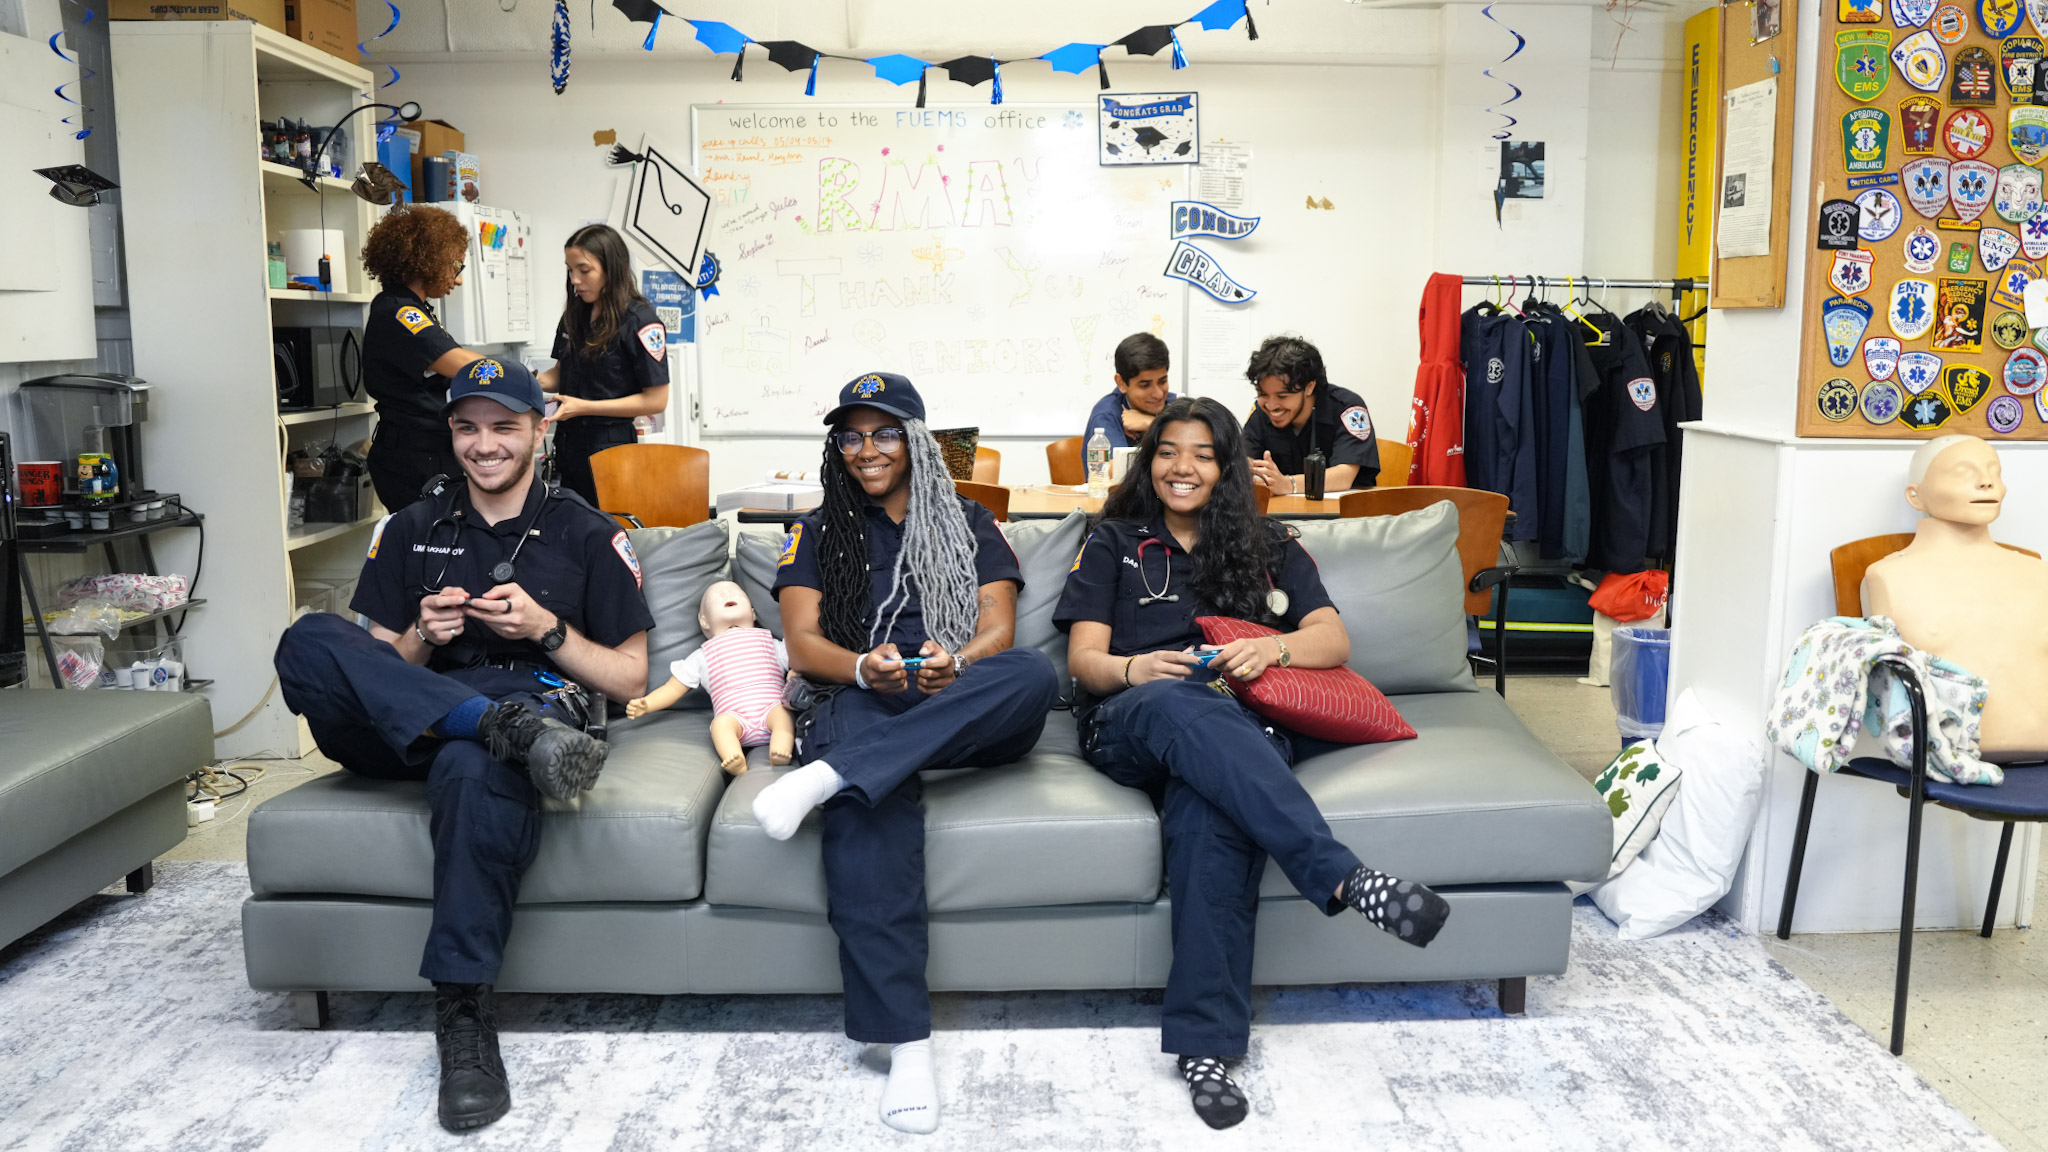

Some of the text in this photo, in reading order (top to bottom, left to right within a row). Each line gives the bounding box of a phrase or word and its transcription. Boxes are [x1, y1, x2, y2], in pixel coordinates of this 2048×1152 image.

[1839, 33, 1855, 44] NEW
[1904, 33, 1928, 52] EMT
[1854, 82, 1882, 92] EMS
[2012, 85, 2032, 93] EMS
[1113, 104, 1183, 117] CONGRATS GRAD
[1910, 104, 1931, 112] EMS
[729, 110, 1047, 129] welcome to the FUEMS office
[1850, 110, 1884, 121] APPROVED
[1684, 43, 1700, 246] EMERGENCY
[1849, 160, 1883, 170] AMBULANCE
[1176, 206, 1255, 235] CONGRATS
[2008, 211, 2028, 219] EMS
[1983, 239, 2011, 255] EMS
[1174, 249, 1234, 298] GRAD
[1898, 282, 1928, 294] EMT
[1829, 298, 1868, 311] PARAMEDIC
[1875, 339, 1889, 347] RT
[1819, 384, 1830, 398] NEW
[1956, 396, 1972, 406] EMS
[20, 470, 50, 480] ANGER
